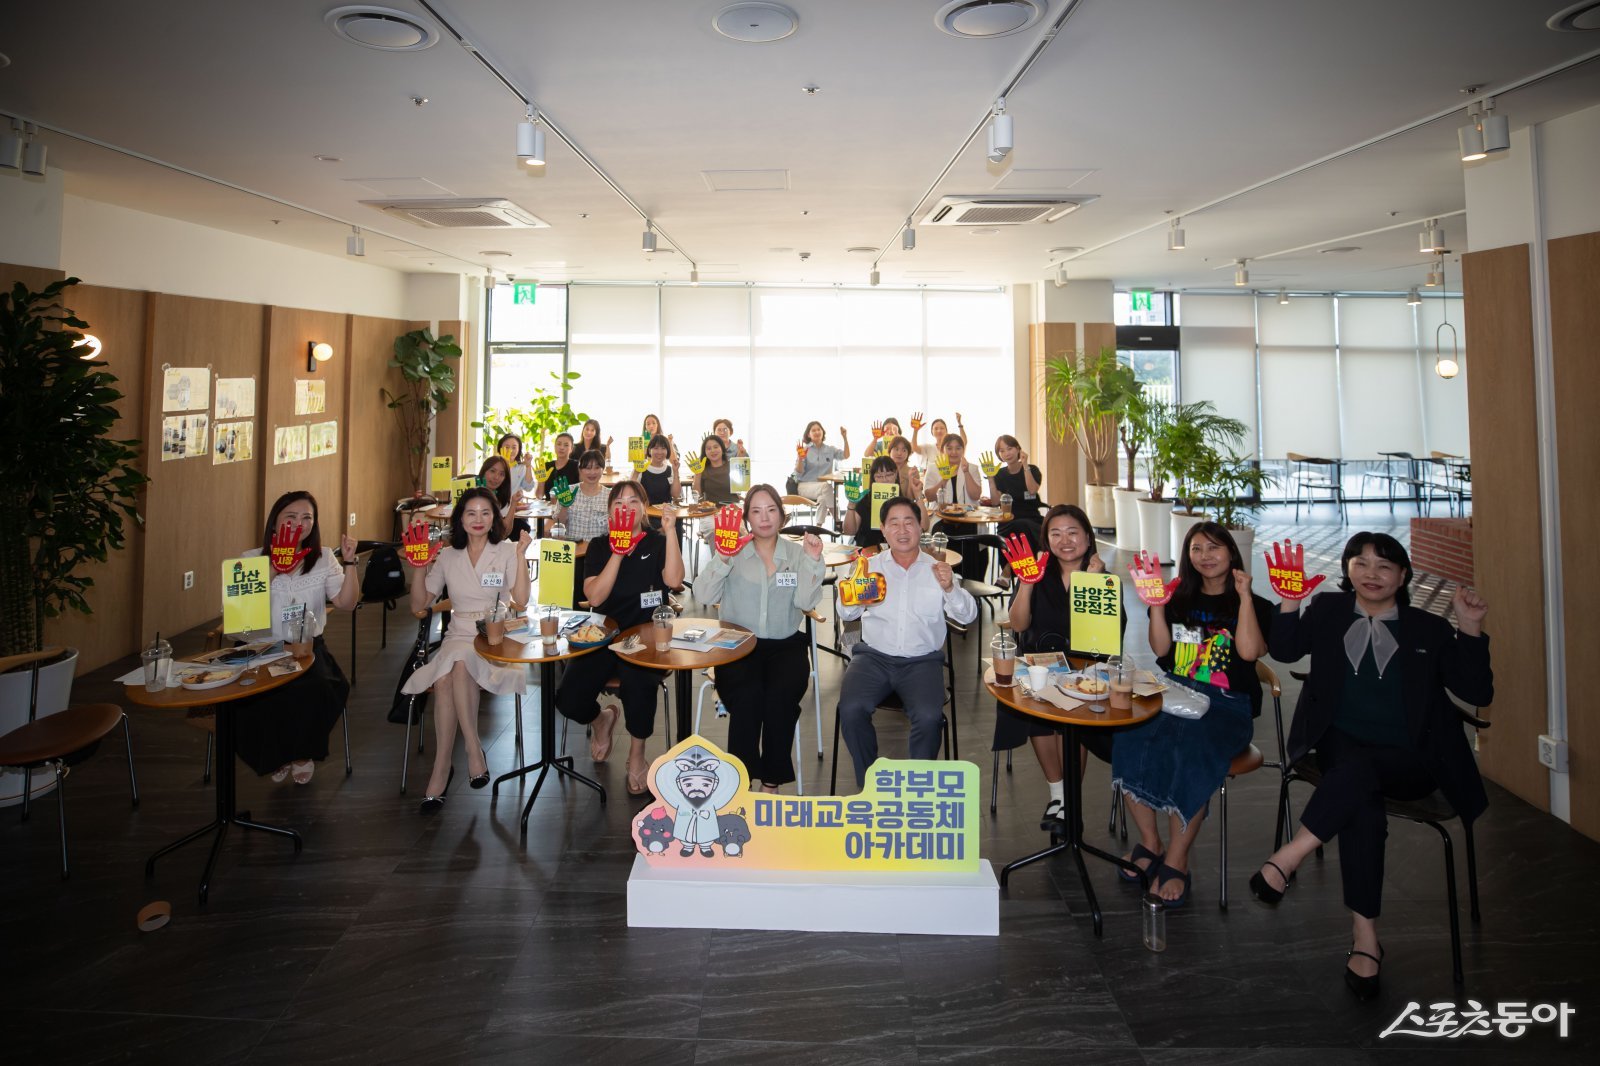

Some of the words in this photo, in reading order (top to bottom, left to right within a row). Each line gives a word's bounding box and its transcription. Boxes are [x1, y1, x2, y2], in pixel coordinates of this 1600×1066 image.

[610, 530, 632, 540] 학부모
[715, 529, 739, 540] 학부모
[405, 543, 429, 553] 학부모
[615, 538, 631, 548] 시장
[720, 539, 737, 549] 시장
[272, 547, 296, 556] 학부모
[412, 552, 429, 561] 시장
[542, 550, 572, 564] 가운초
[277, 556, 294, 565] 시장
[1011, 556, 1036, 570] 학부모
[233, 569, 260, 583] 다산
[1022, 564, 1039, 577] 시장
[1269, 568, 1303, 582] 학부모
[226, 581, 267, 597] 별빛초
[1135, 578, 1163, 588] 학부모
[1280, 580, 1303, 592] 시장
[1073, 585, 1117, 602] 남양주
[1145, 588, 1165, 598] 시장
[1073, 599, 1117, 616] 양정초
[875, 769, 965, 798] 학부모
[754, 799, 965, 829] 미래교육공동체
[845, 831, 964, 860] 아카데미
